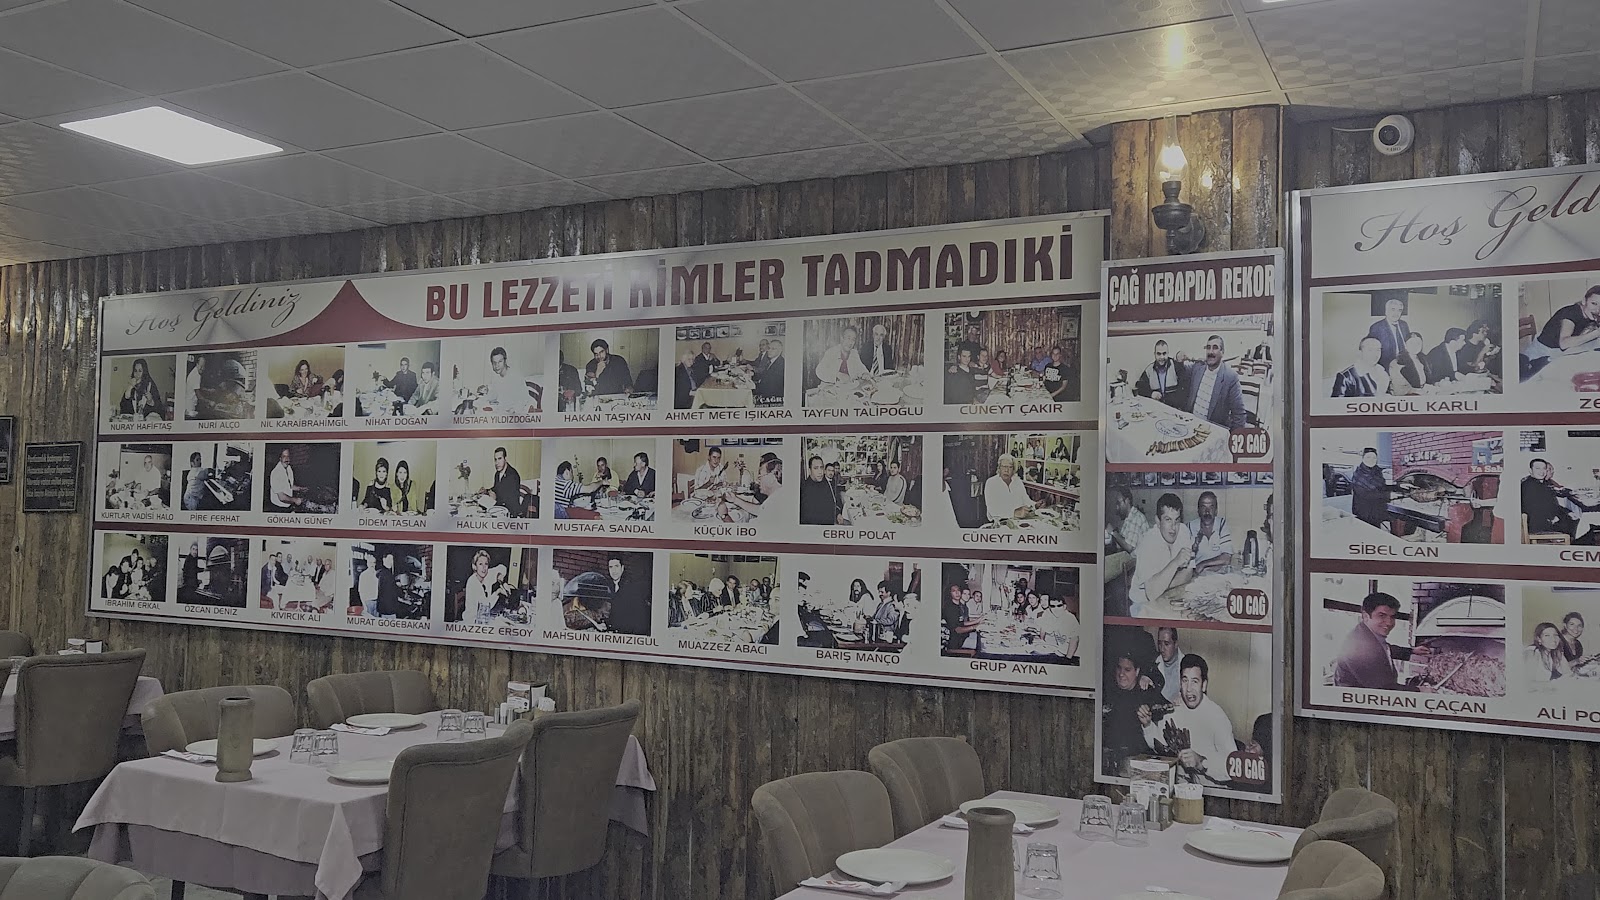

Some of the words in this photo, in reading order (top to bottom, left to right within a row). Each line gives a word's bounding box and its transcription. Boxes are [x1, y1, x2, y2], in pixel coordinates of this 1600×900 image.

[1354, 203, 1467, 252] Hoş
[425, 283, 469, 322] BU
[629, 257, 785, 308] KİMLER
[802, 224, 1073, 297] TADMADIKİ
[1109, 267, 1140, 312] ÇAĞ
[1144, 268, 1217, 304] KEBAPDA
[1221, 264, 1275, 300] REKOR
[125, 312, 182, 336] Hoş
[185, 287, 302, 342] Geldiniz
[802, 408, 849, 418] TAYFUN
[853, 405, 924, 418] TALİPOĞLU
[960, 401, 1015, 415] CÜNEYT
[1020, 403, 1063, 416] ÇAKIR
[1346, 399, 1419, 413] SONGÜL
[1426, 400, 1478, 412] KARLI
[365, 417, 391, 426] NİHAT
[394, 416, 428, 426] DOĞAN
[453, 415, 488, 425] MUSTAFA
[564, 413, 601, 423] HAKAN
[605, 412, 651, 424] TAŞIYAN
[665, 410, 705, 421] AHMET
[709, 410, 740, 420] METE
[744, 409, 793, 422] IŞIKARA
[110, 422, 134, 431] NURAY
[219, 421, 240, 431] ALÇO
[1231, 434, 1245, 454] 32
[1246, 429, 1267, 454] CAĞ
[101, 511, 130, 520] KURTLAR
[156, 513, 174, 521] HALO
[190, 513, 208, 522] PİRE
[210, 514, 241, 522] FERHAT
[266, 515, 301, 525] GÖKHAN
[304, 515, 333, 525] GÜNEY
[358, 517, 388, 527] DİDEM
[391, 518, 427, 528] TASLAN
[456, 520, 489, 530] HALUK
[491, 521, 530, 531] LEVENT
[554, 523, 605, 533] MUSTAFA
[609, 524, 655, 534] SANDAL
[693, 524, 732, 538] KÜÇÜK
[736, 525, 757, 537] İBO
[823, 529, 854, 539] EBRU
[858, 530, 897, 541] POLAT
[962, 531, 1013, 544] CÜNEYT
[1017, 534, 1058, 545] ARKIN
[1349, 541, 1398, 556] SİBEL
[1402, 546, 1439, 558] CAN
[1559, 550, 1600, 562] CEM
[137, 601, 161, 610] ERKAL
[1229, 594, 1243, 615] 30
[1245, 592, 1266, 616] CAĞ
[271, 611, 304, 621] KIVIRCIK
[346, 617, 376, 627] MURAT
[445, 623, 495, 635] MUAZZEZ
[498, 627, 534, 638] ERSOY
[542, 630, 590, 642] MAHSUN
[678, 639, 731, 652] MUAZZEZ
[734, 642, 768, 655] ABACI
[816, 649, 852, 664] BARIŞ
[856, 652, 900, 667] MANÇO
[970, 660, 1007, 673] GRUP
[1011, 664, 1048, 675] AYNA
[1342, 692, 1417, 708] BURHAN
[1424, 698, 1486, 715] ÇAÇAN
[1537, 706, 1566, 720] ALİ
[1575, 710, 1600, 723] PO
[1229, 757, 1242, 778] 28
[1244, 756, 1265, 781] CAĞ
